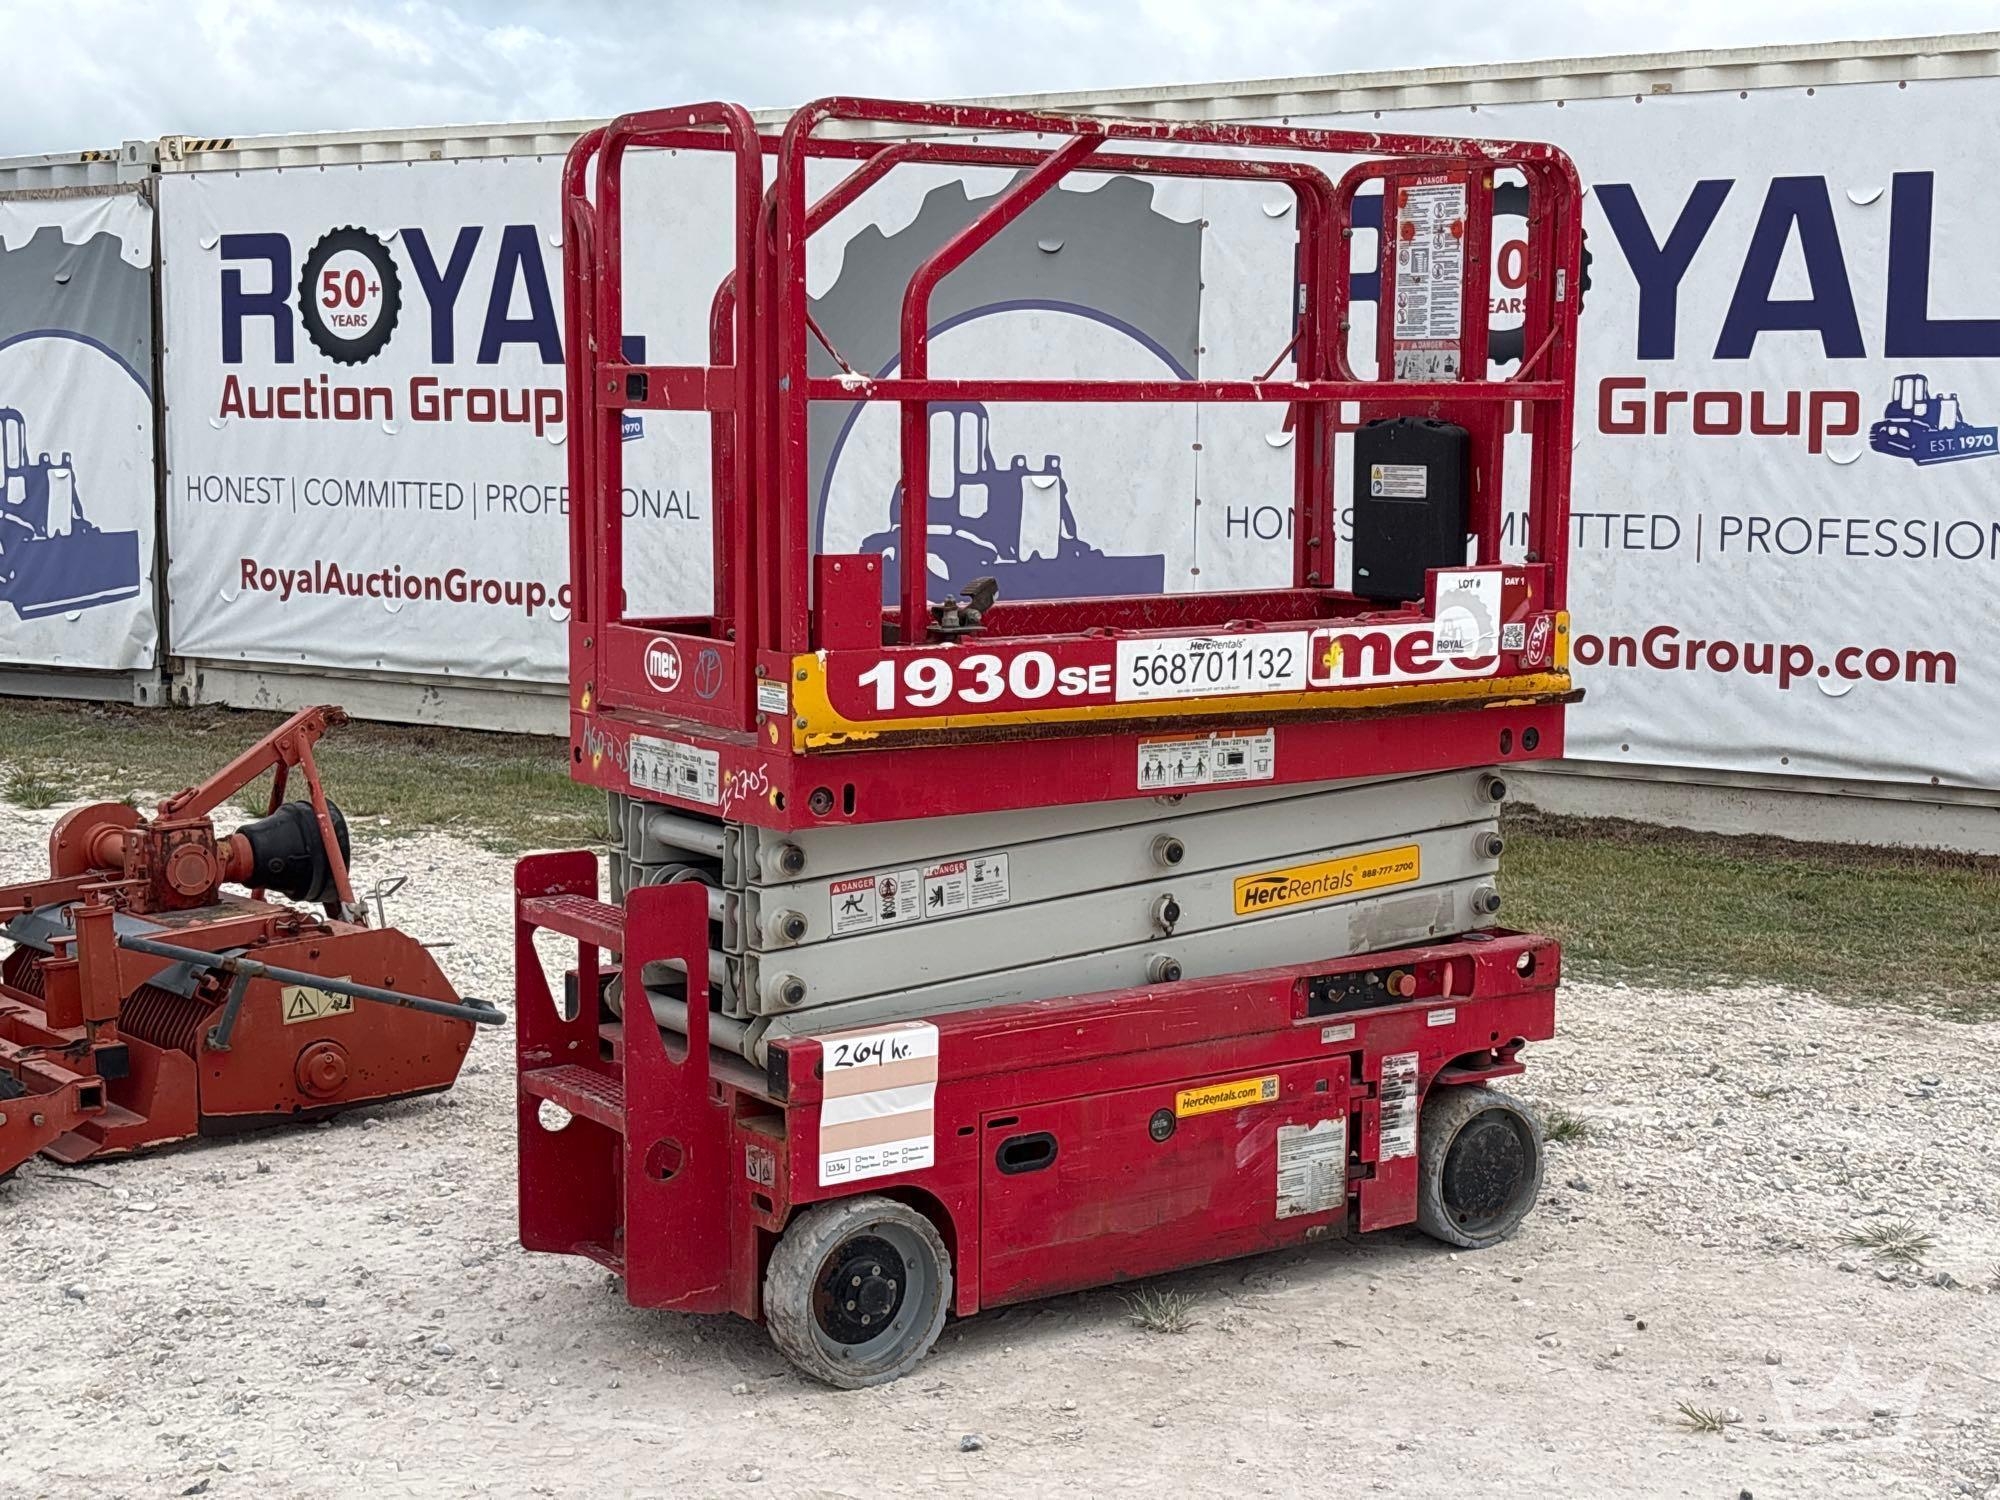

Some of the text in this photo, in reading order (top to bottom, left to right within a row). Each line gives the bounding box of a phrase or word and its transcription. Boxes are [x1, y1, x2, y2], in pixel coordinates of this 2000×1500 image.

[1423, 176, 1448, 185] DANGER
[220, 224, 645, 367] ROYA
[322, 268, 381, 309] 50+
[331, 314, 368, 328] YEARS
[219, 373, 564, 437] Auction Group
[1598, 376, 1861, 454] Group
[1930, 434, 1993, 452] EST. 1970
[186, 475, 286, 506] HONEST
[304, 478, 464, 511] COMMITTED
[1458, 579, 1475, 589] LOT
[1505, 577, 1520, 586] DAY
[1437, 640, 1464, 649] ROYAL
[1573, 625, 1957, 690] onGroup.com
[650, 650, 677, 680] mec
[1132, 647, 1293, 687] 568701132
[841, 879, 874, 892] DANGER
[1182, 1087, 1257, 1109] HercRentals.com
